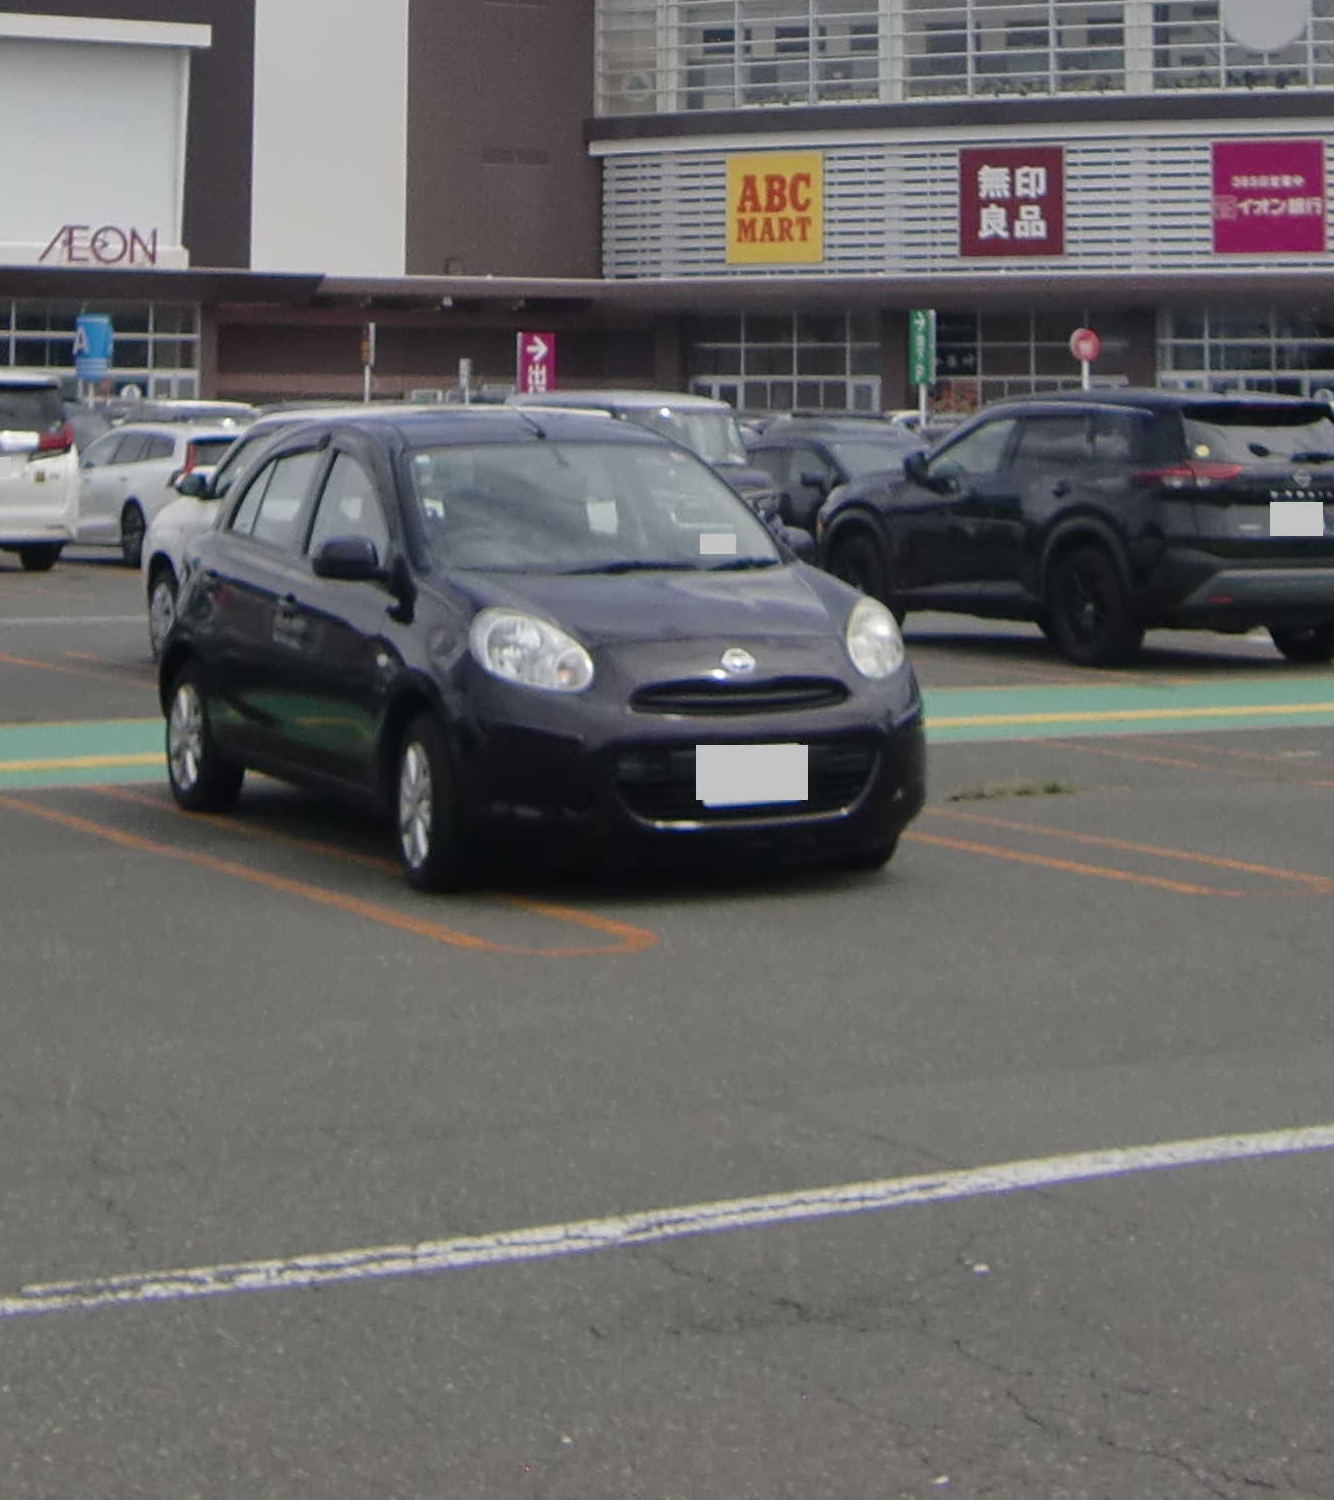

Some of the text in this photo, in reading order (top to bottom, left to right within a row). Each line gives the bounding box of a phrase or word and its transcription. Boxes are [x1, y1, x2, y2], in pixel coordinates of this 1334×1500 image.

[736, 172, 812, 213] ABC
[977, 164, 1048, 199] 無印
[736, 216, 813, 243] MART
[977, 203, 1048, 239] 良品
[73, 327, 89, 355] A
